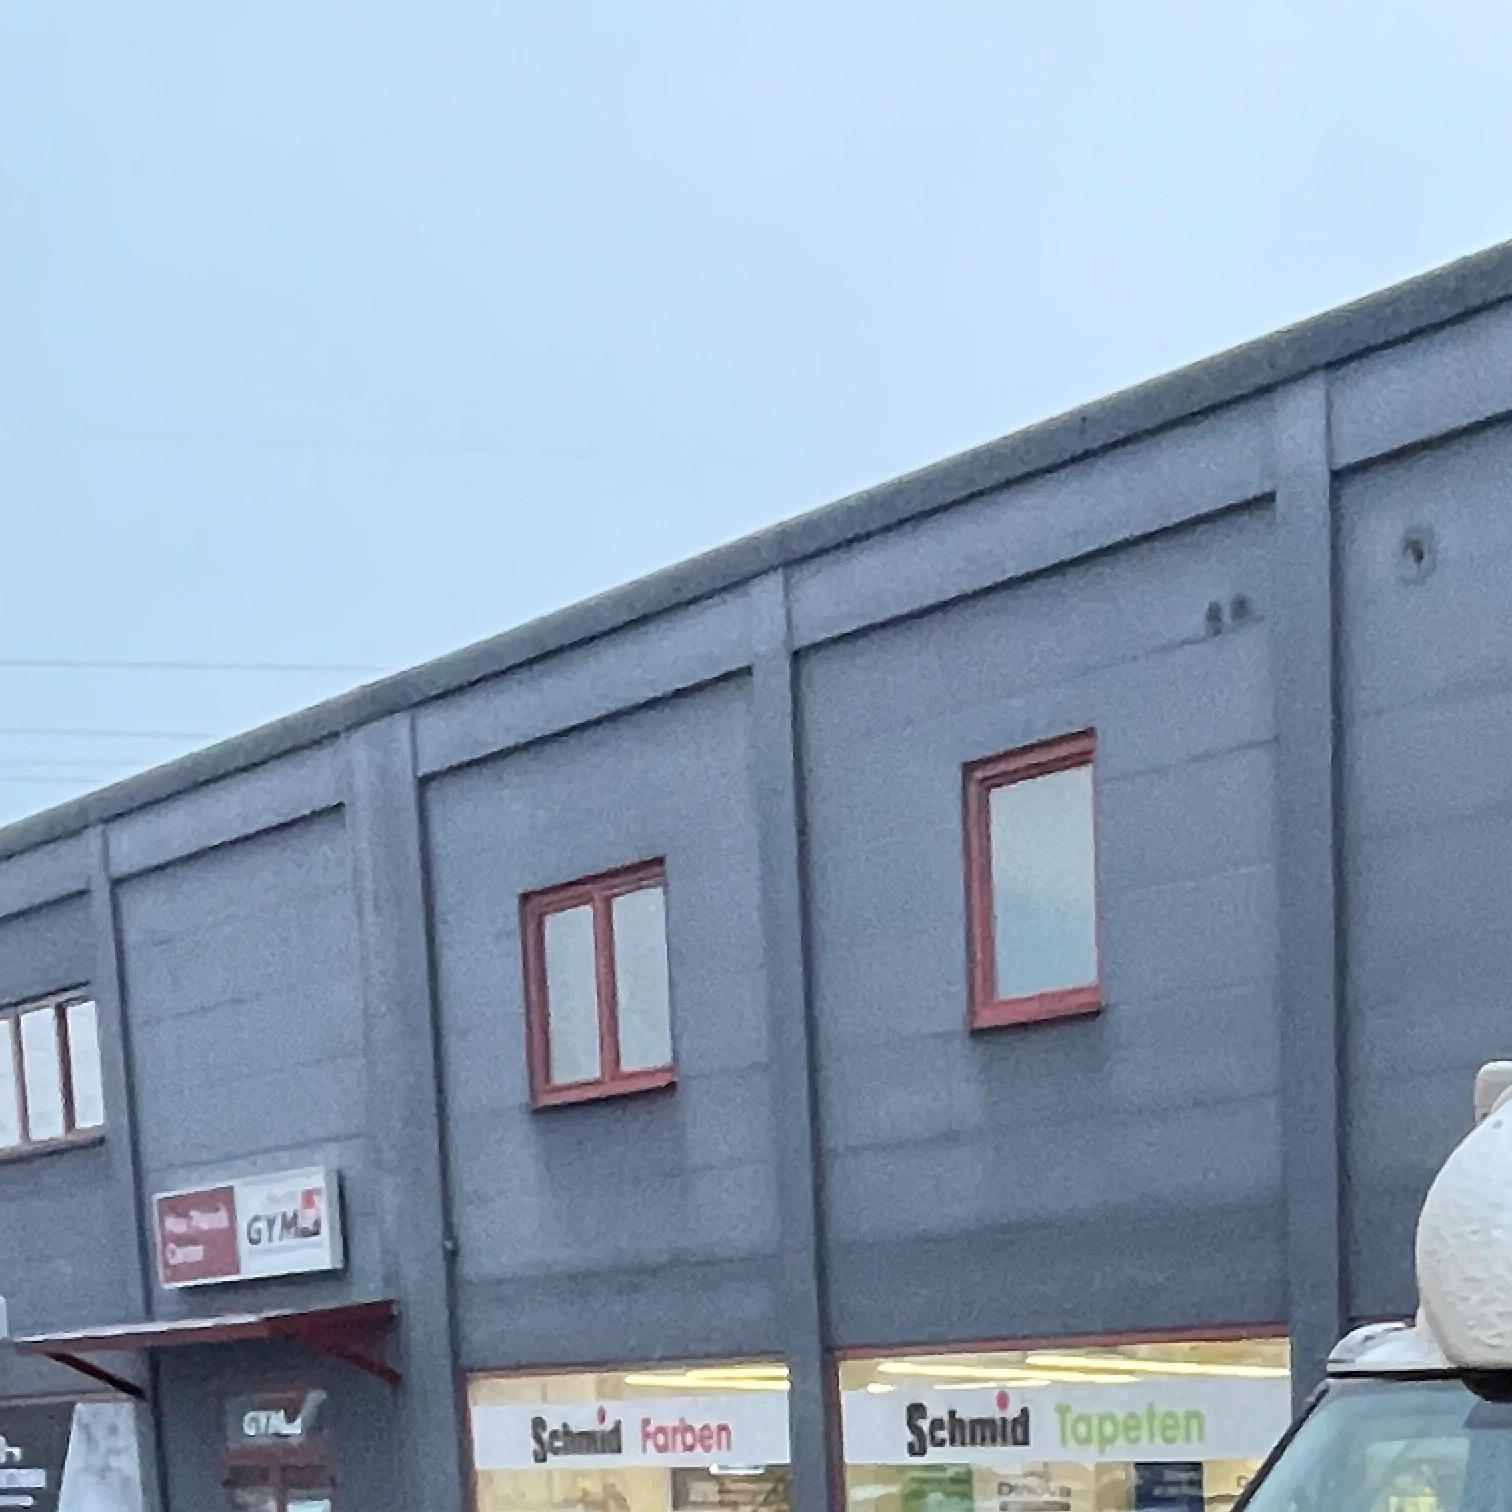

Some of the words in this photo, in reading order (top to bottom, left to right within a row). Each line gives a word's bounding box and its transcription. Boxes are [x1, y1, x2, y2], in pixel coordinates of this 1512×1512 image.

[531, 1405, 623, 1464] Schmid
[640, 1416, 732, 1454] Farben
[906, 1390, 1031, 1458] Schmid
[1055, 1402, 1206, 1454] Tapeten
